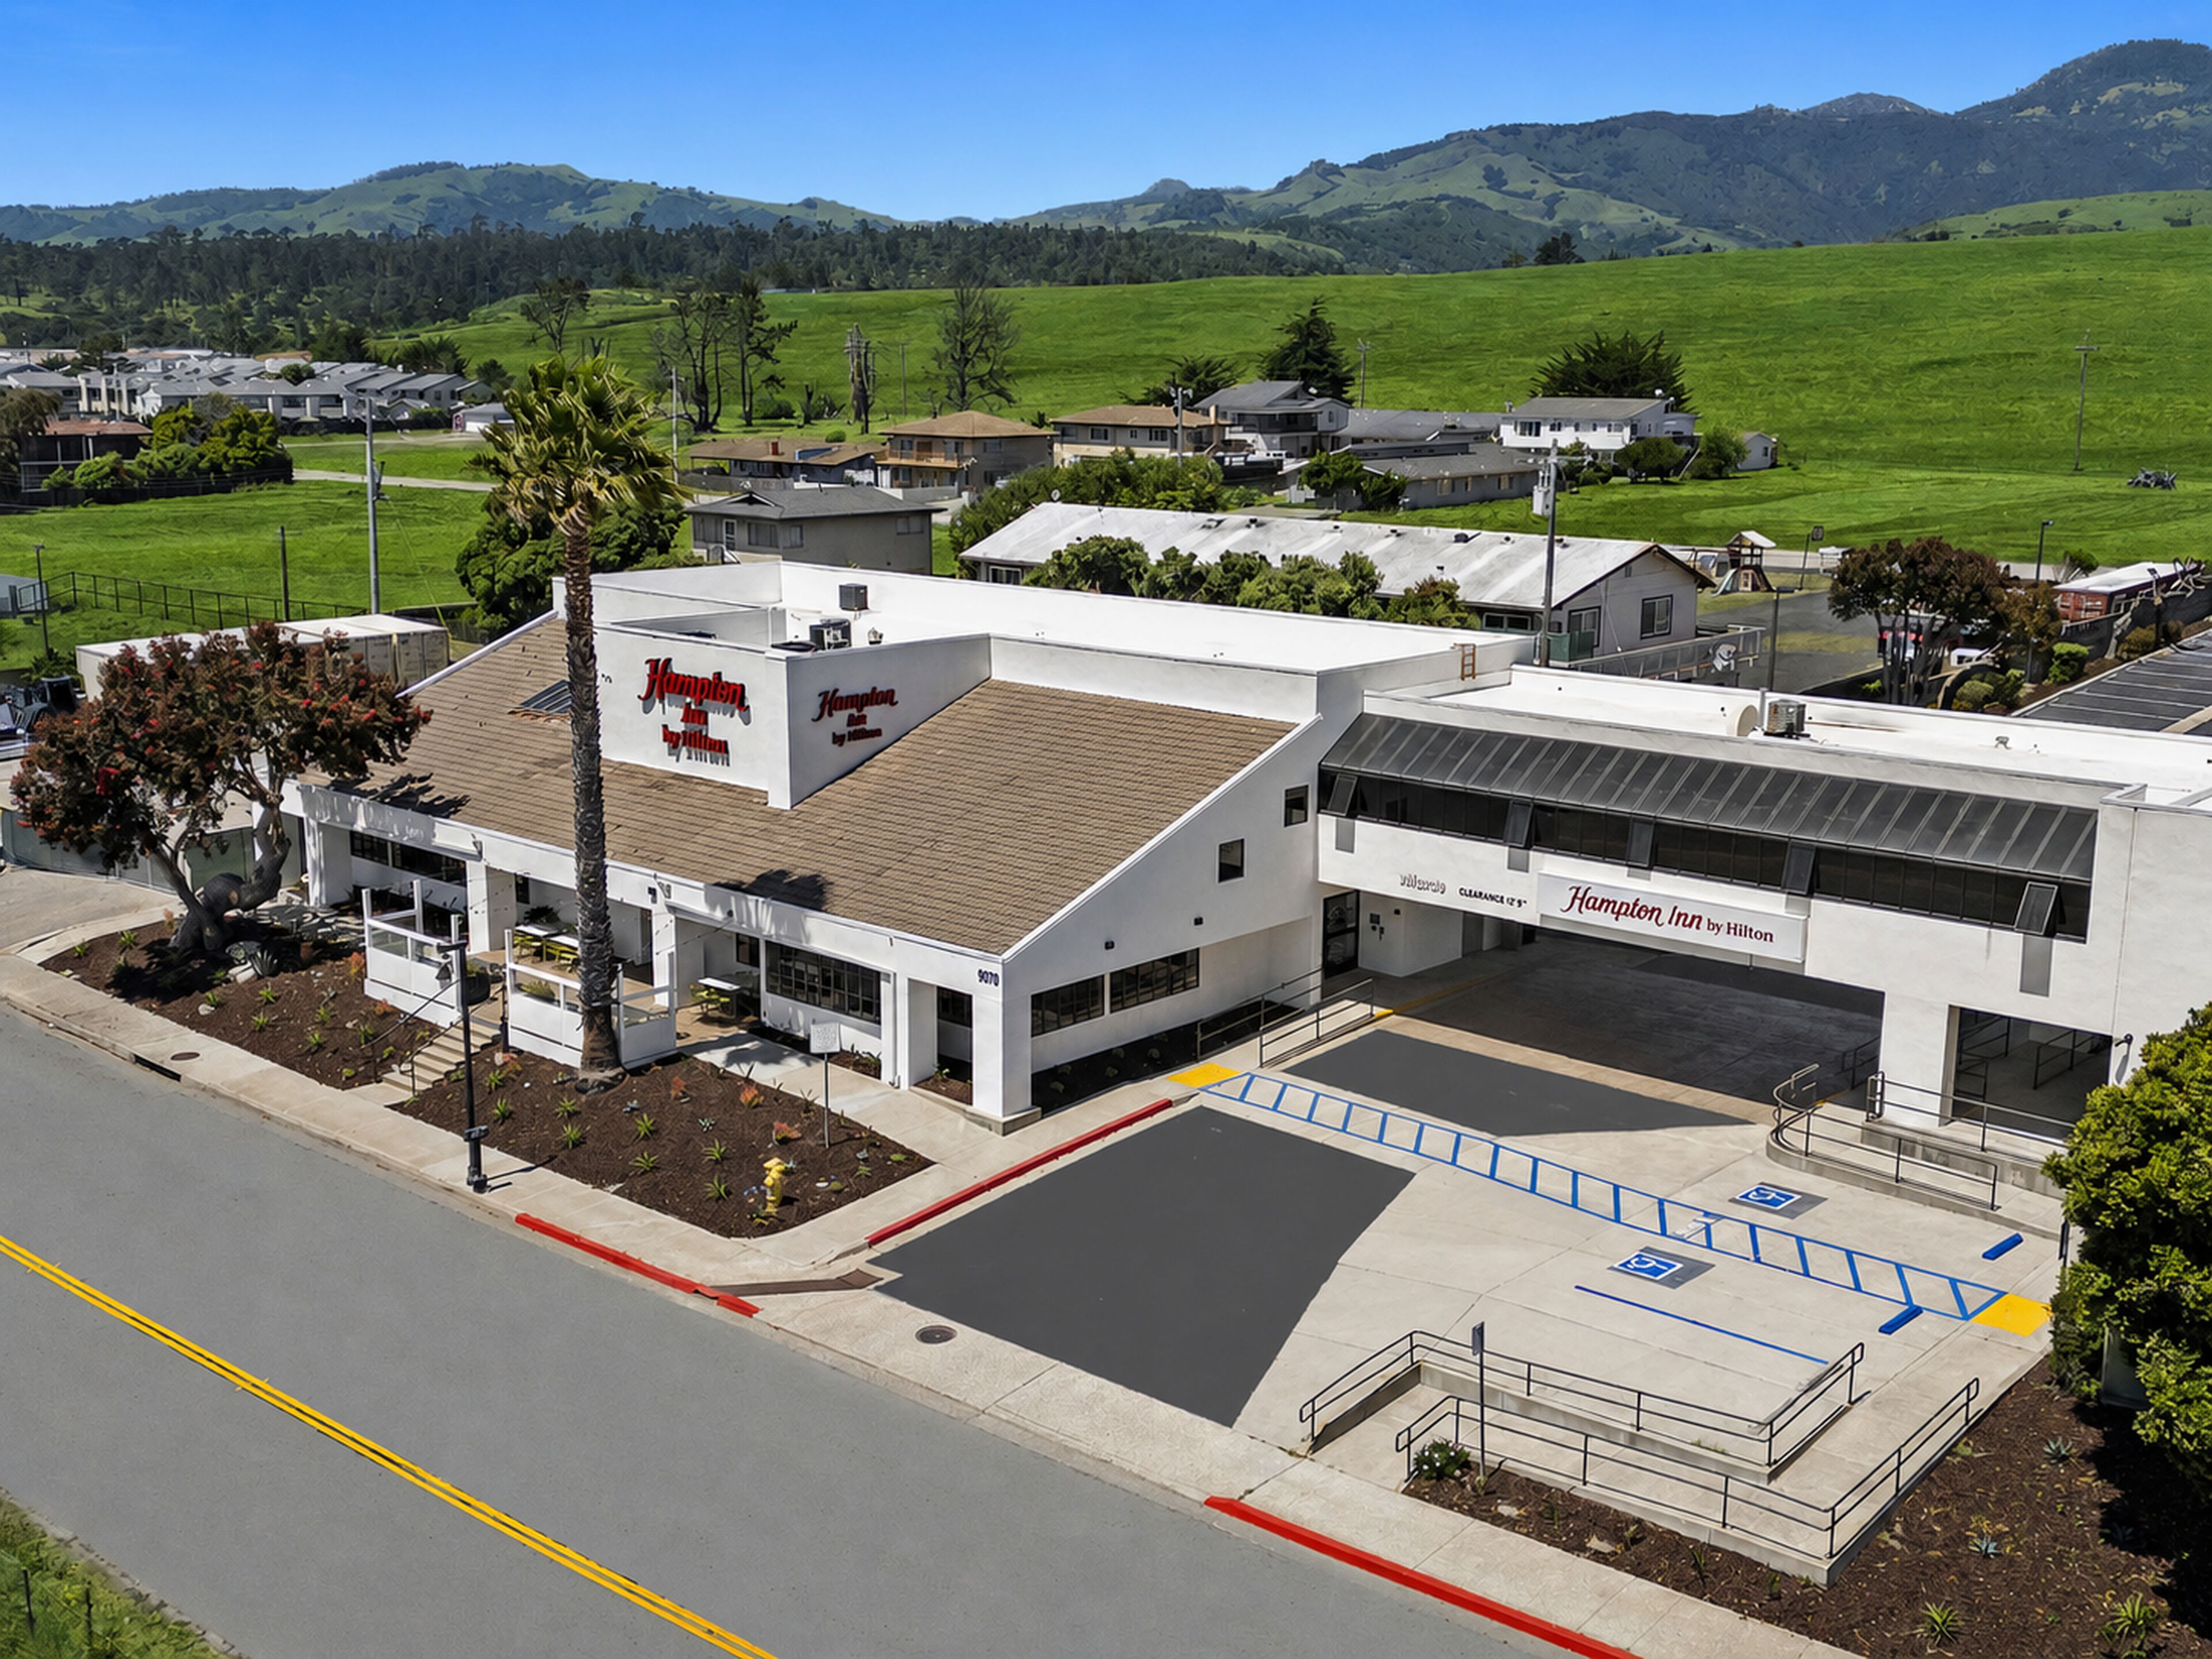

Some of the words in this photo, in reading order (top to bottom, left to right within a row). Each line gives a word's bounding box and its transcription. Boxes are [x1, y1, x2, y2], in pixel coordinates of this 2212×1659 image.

[637, 657, 749, 711] Hampton
[811, 686, 899, 722] Hampton
[662, 724, 681, 749] by
[832, 732, 846, 747] by
[1459, 888, 1505, 904] CLEARANCE
[1560, 885, 1664, 927] Hampton
[1667, 906, 1703, 931] Inn
[1707, 918, 1724, 935] by
[1726, 922, 1775, 943] Hilton
[978, 969, 999, 987] 9070
